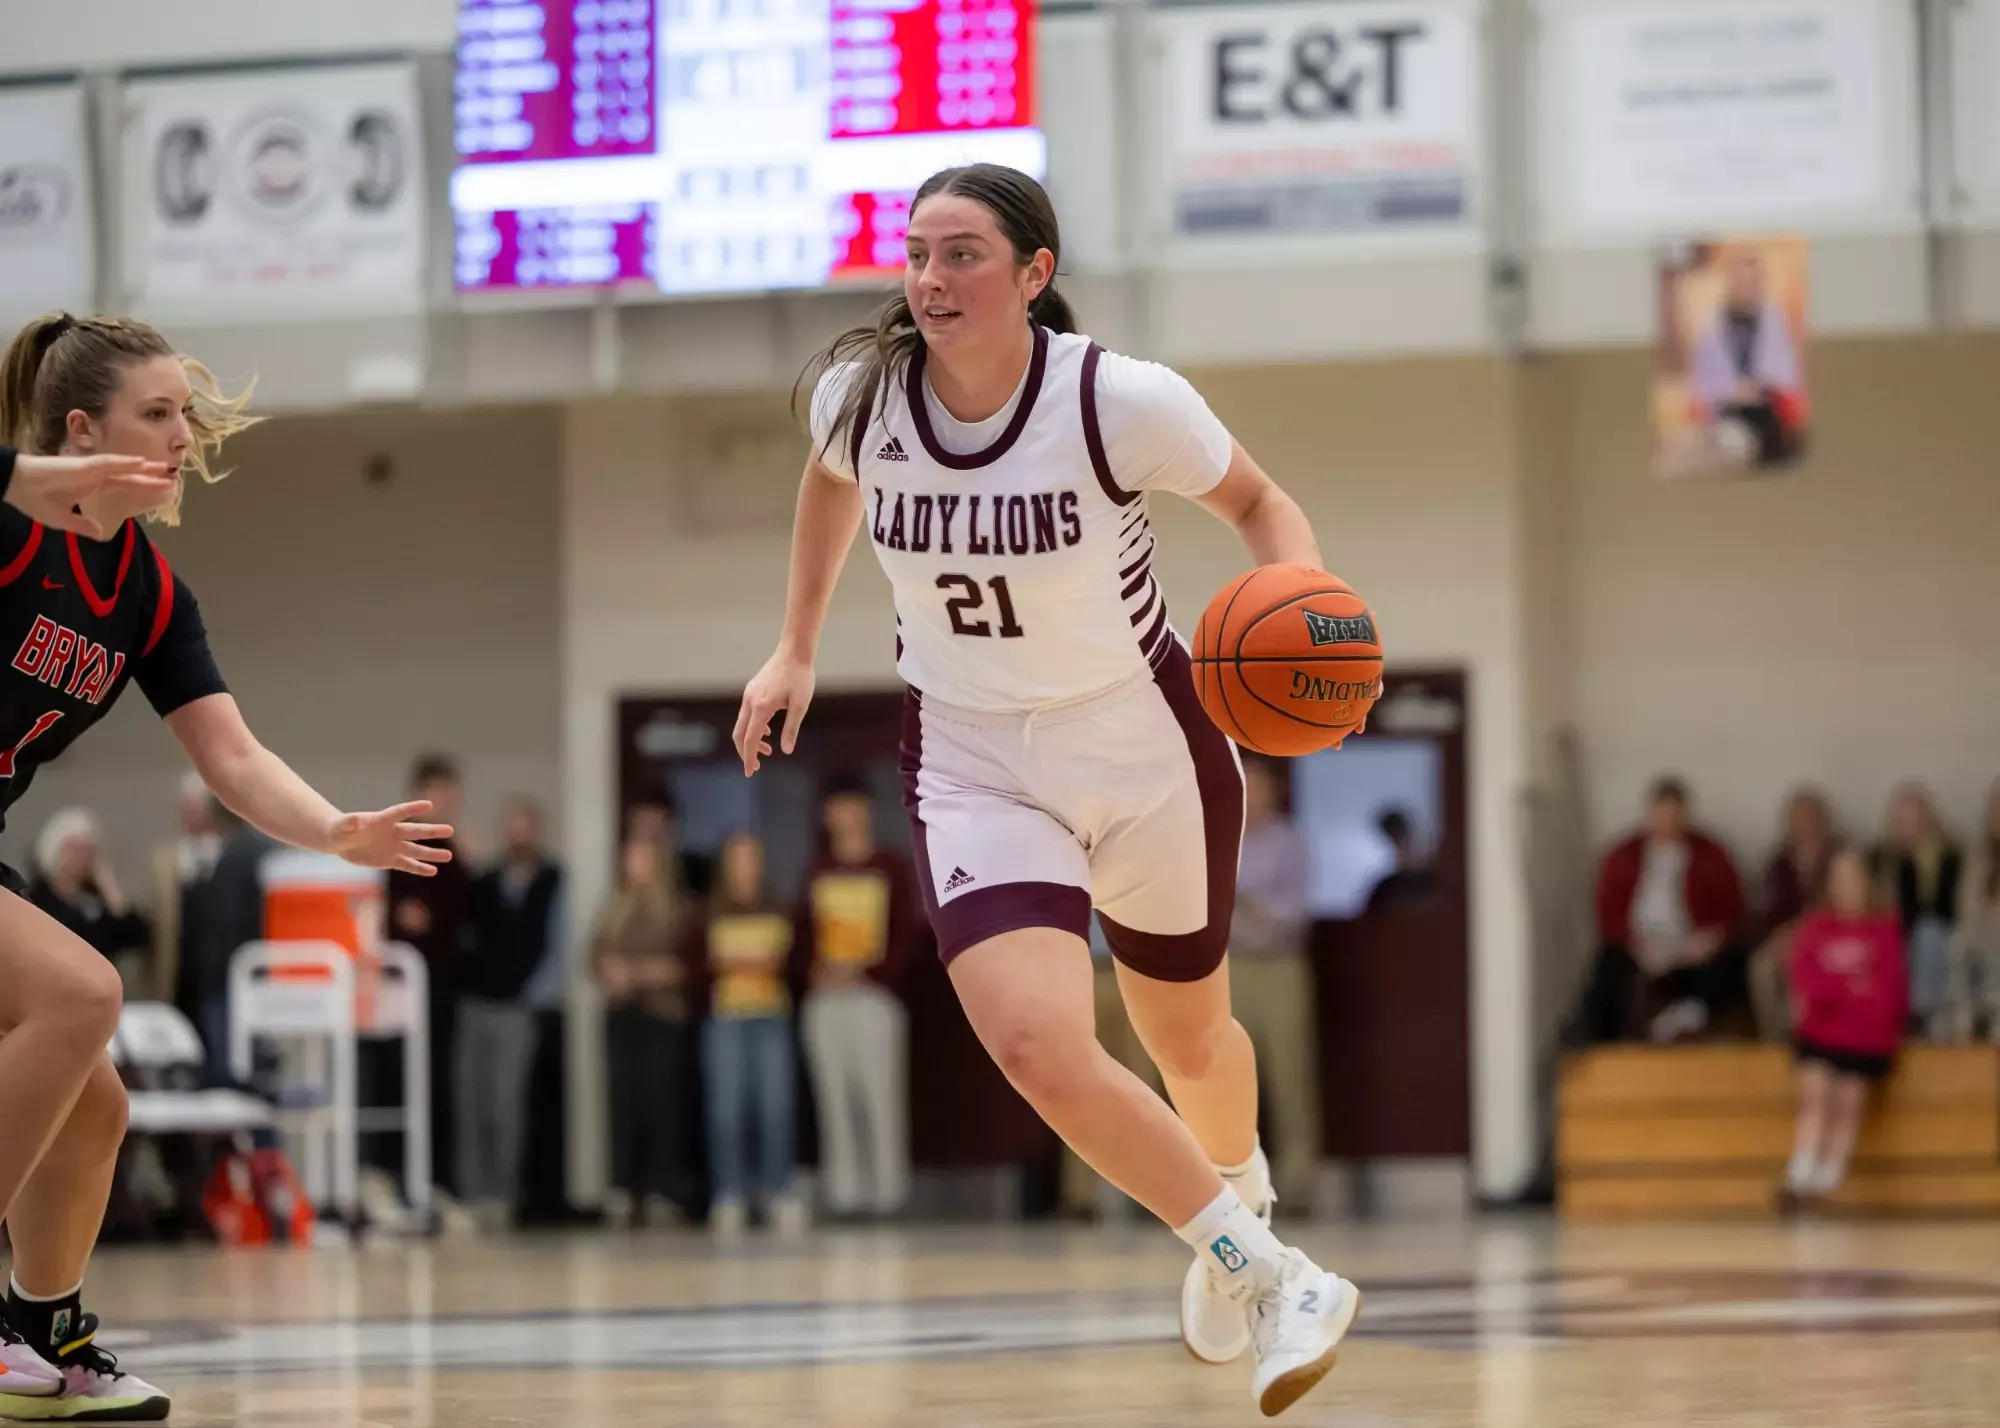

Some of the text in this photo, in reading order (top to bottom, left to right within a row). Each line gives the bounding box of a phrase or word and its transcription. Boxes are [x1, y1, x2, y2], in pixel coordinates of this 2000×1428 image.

[1212, 24, 1427, 122] E&T
[877, 451, 909, 462] adidas
[873, 485, 1082, 556] LADY LIONS
[934, 572, 1024, 638] 21
[1304, 611, 1377, 645] NAIA
[1289, 669, 1381, 701] PALDING
[944, 876, 975, 893] adidas
